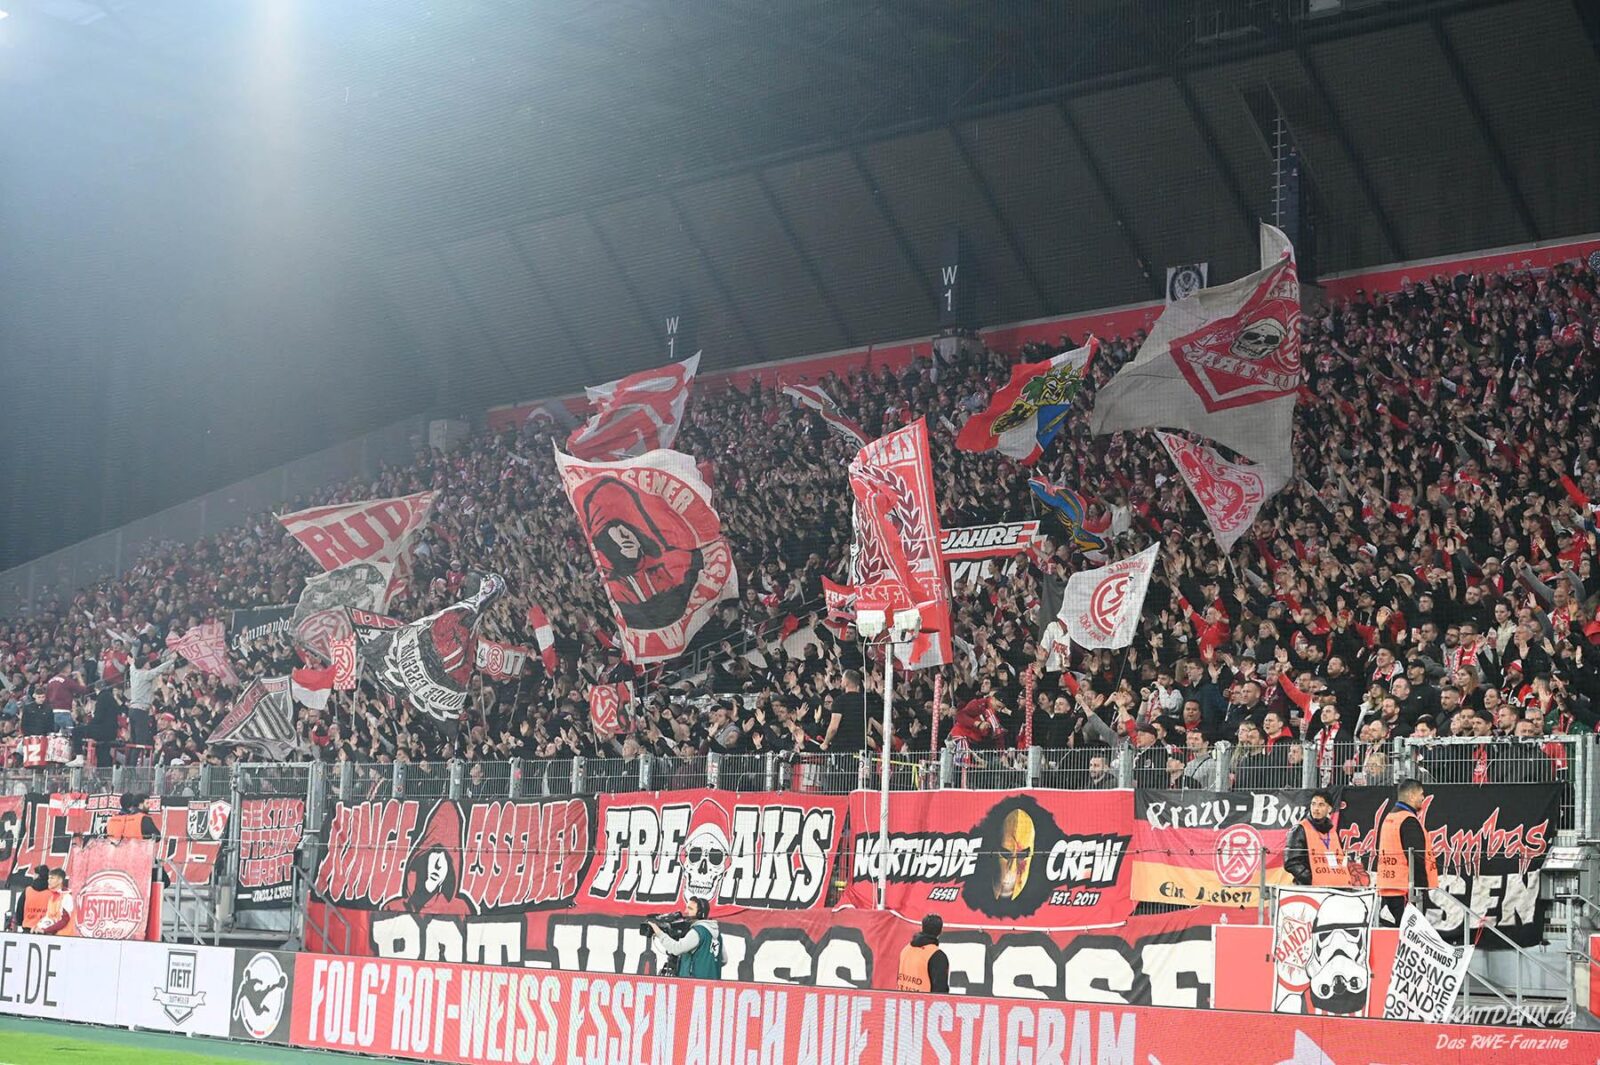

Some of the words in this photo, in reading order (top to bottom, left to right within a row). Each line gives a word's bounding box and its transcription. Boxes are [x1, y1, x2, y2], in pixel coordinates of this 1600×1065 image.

[942, 265, 958, 285] W
[944, 289, 951, 311] 1
[666, 316, 679, 335] W
[668, 337, 674, 358] 1
[942, 524, 1023, 551] JAHRE
[231, 617, 290, 650] Cmmando
[1146, 799, 1230, 832] Crazy
[315, 799, 419, 903] JUNGE
[460, 798, 590, 908] ESSENER
[588, 803, 836, 910] FREAKS
[853, 836, 983, 879] NORTHSIDE
[1046, 838, 1125, 884] CREW
[928, 887, 960, 901] ESSEN
[1049, 891, 1072, 906] EST.
[1073, 891, 1100, 906] 2011
[1276, 921, 1315, 965] BANDA
[1424, 945, 1454, 968] STANDS
[1395, 957, 1424, 988] ROM
[1426, 980, 1451, 1007] THE
[1397, 942, 1457, 992] MISSING
[391, 961, 560, 1064] ROT-WEISS
[567, 977, 678, 1065] ESSEN
[686, 985, 788, 1065] AUCH
[799, 993, 873, 1065] AUF
[883, 998, 1137, 1065] INSTAGRAM
